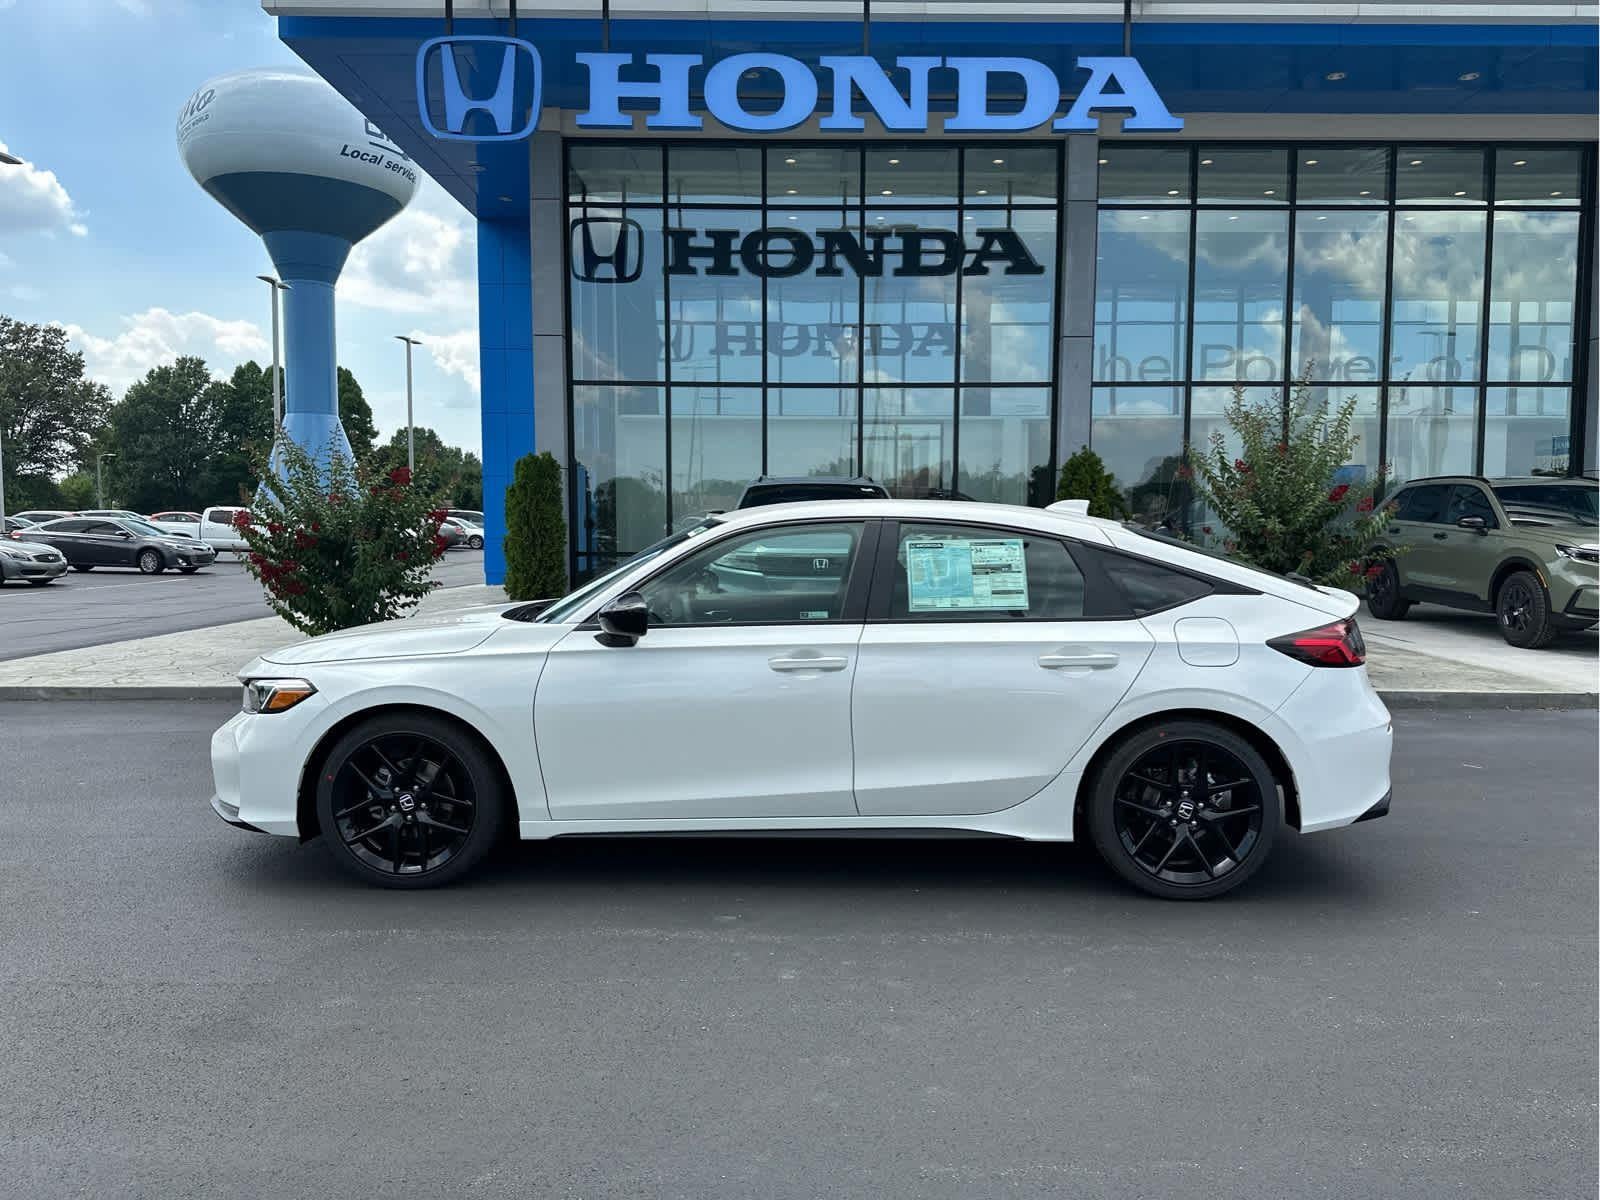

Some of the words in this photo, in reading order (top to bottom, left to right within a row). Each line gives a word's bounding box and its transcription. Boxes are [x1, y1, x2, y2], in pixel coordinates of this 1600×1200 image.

[575, 52, 1185, 132] HONDA
[340, 144, 385, 166] Local
[665, 227, 1046, 277] HONDA
[1100, 344, 1172, 381] he
